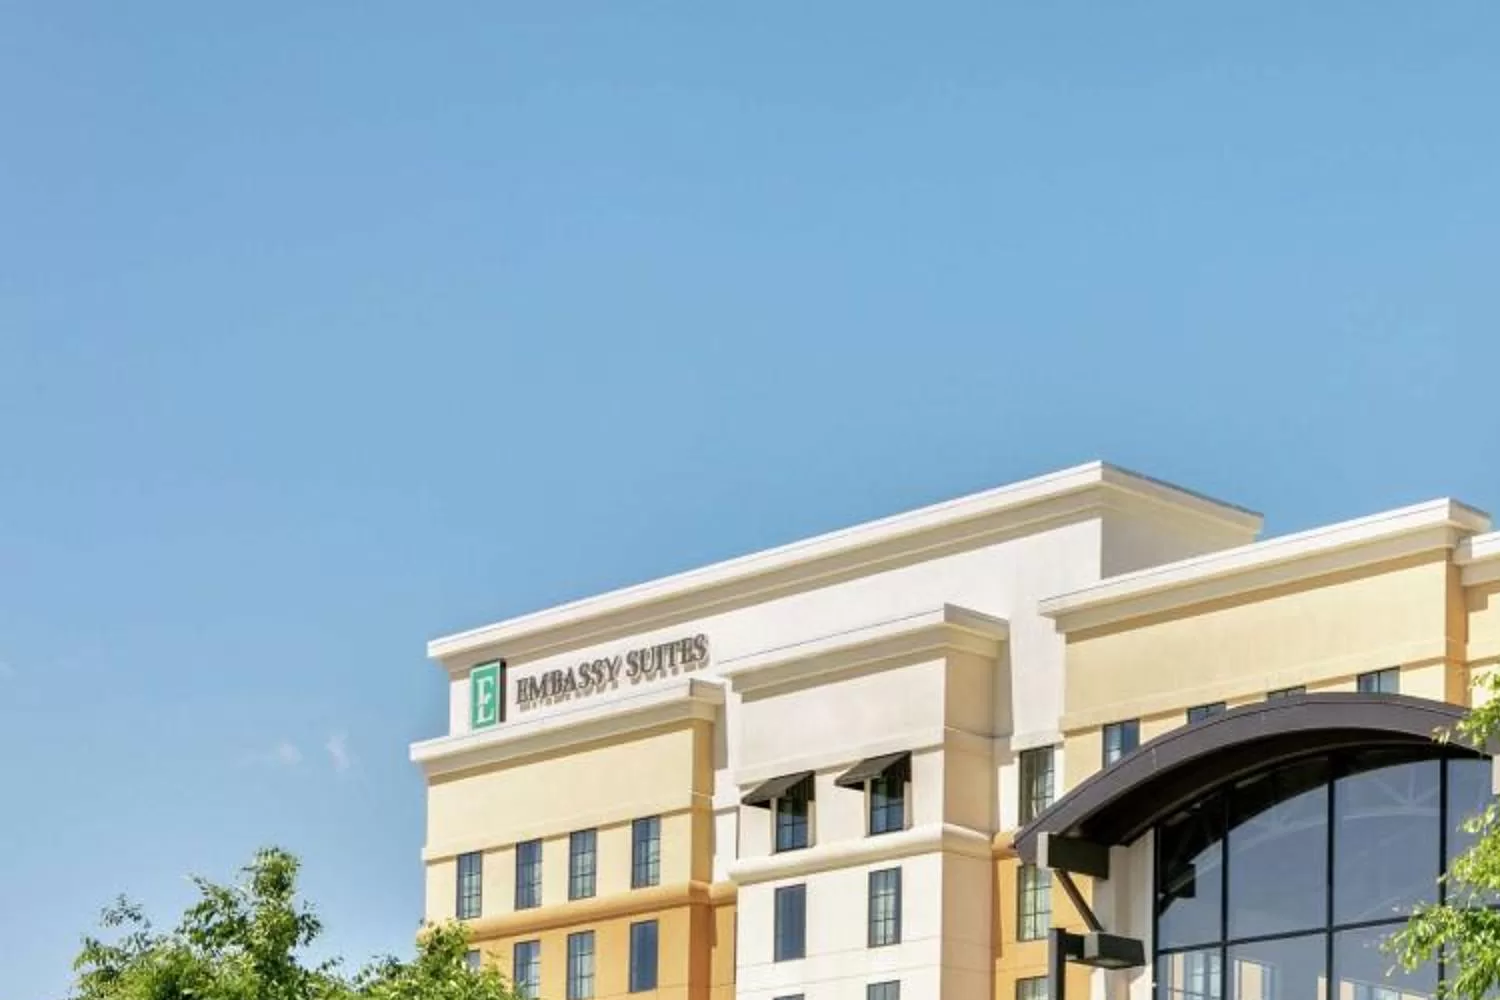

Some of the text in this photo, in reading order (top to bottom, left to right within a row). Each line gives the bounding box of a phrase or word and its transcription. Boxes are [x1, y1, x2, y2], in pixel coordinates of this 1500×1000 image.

[476, 633, 708, 725] E EMBASSY SUITES
